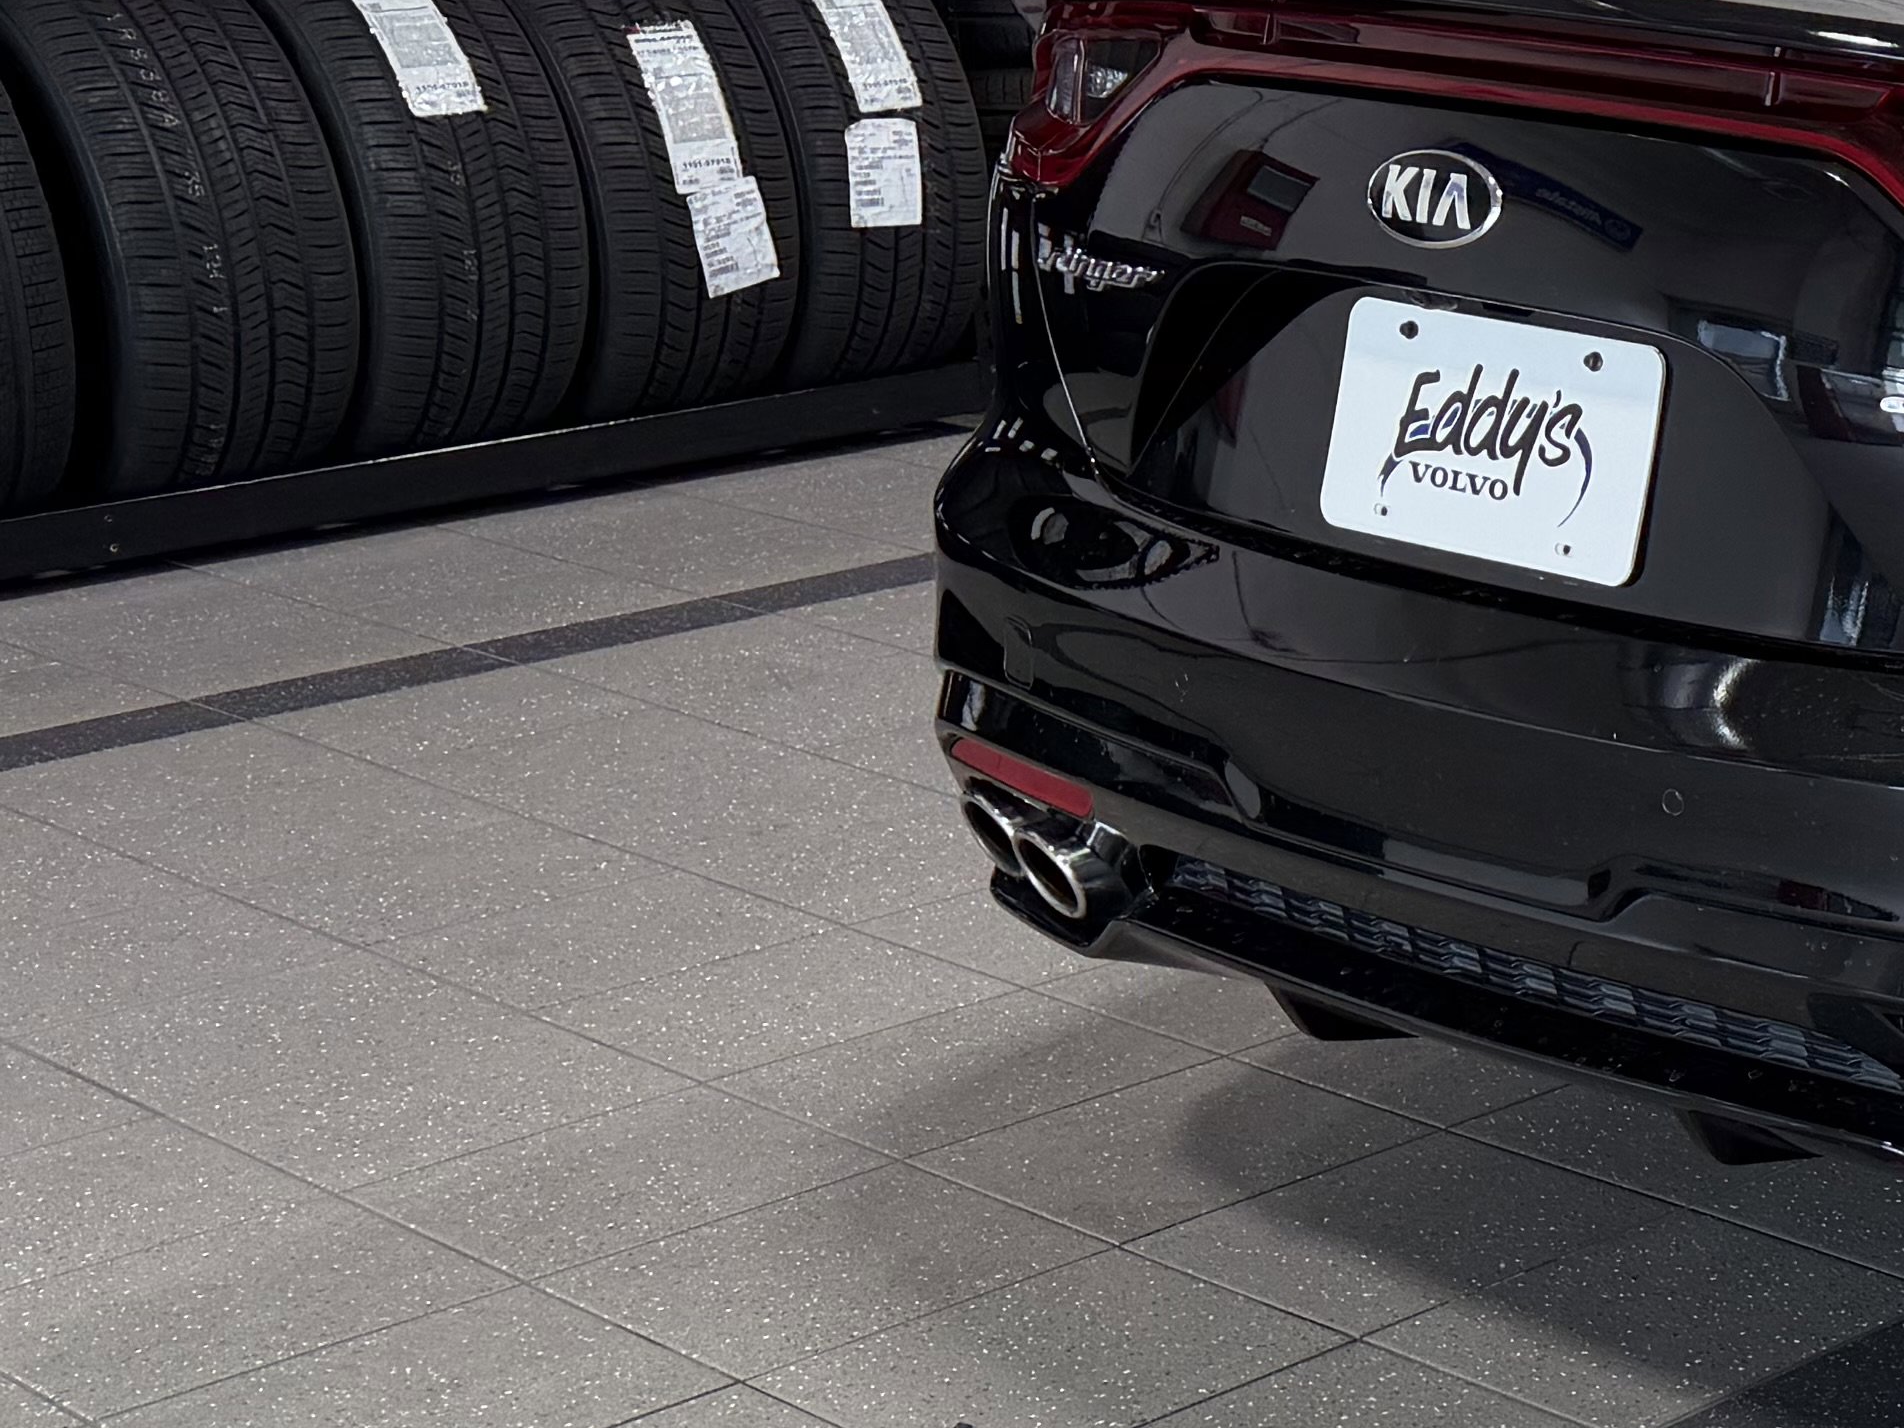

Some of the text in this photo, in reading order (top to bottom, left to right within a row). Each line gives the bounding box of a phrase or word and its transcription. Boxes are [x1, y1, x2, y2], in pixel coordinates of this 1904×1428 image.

[1381, 163, 1471, 230] KIA
[1393, 363, 1584, 497] Eddy's
[1408, 460, 1509, 501] VOLVO
